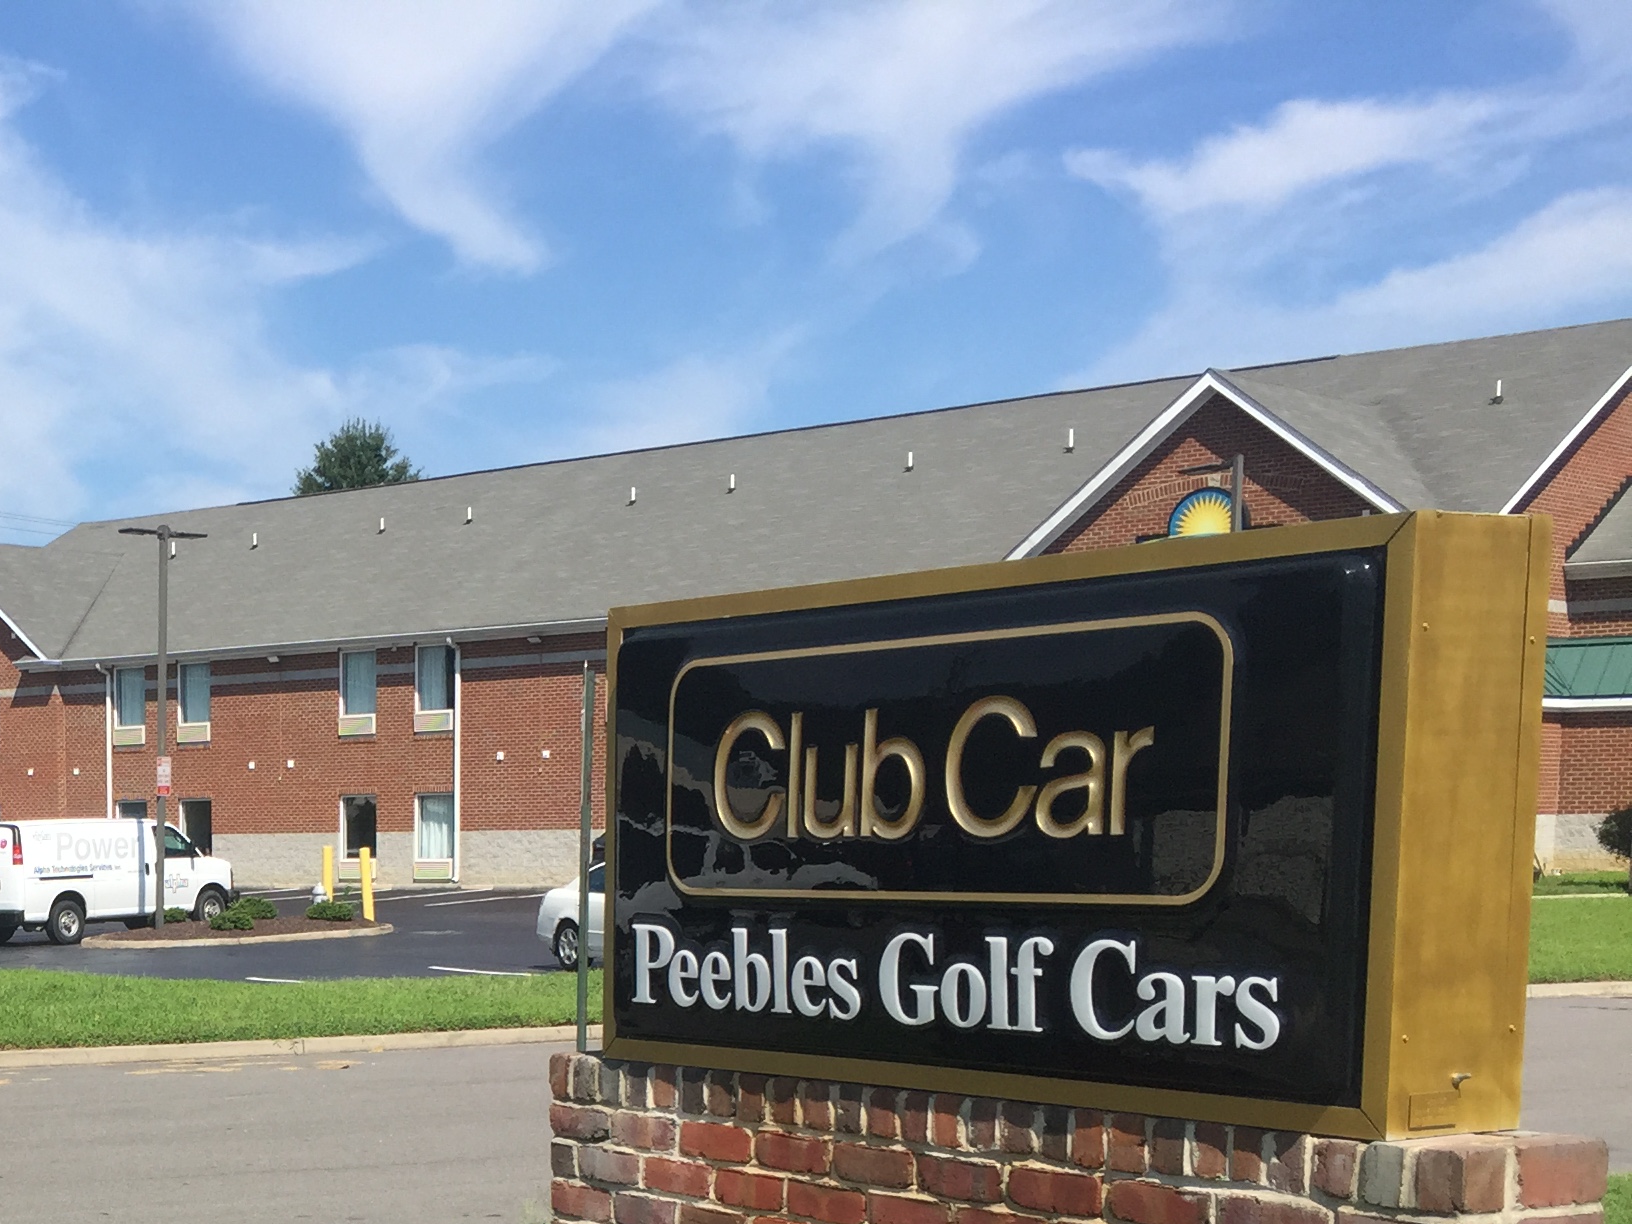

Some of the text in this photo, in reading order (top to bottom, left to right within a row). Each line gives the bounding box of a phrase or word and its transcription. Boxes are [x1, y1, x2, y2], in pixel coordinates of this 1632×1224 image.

[713, 695, 1156, 841] Club Car
[56, 832, 139, 861] Power
[631, 923, 1283, 1052] Peebles Golf Cars
